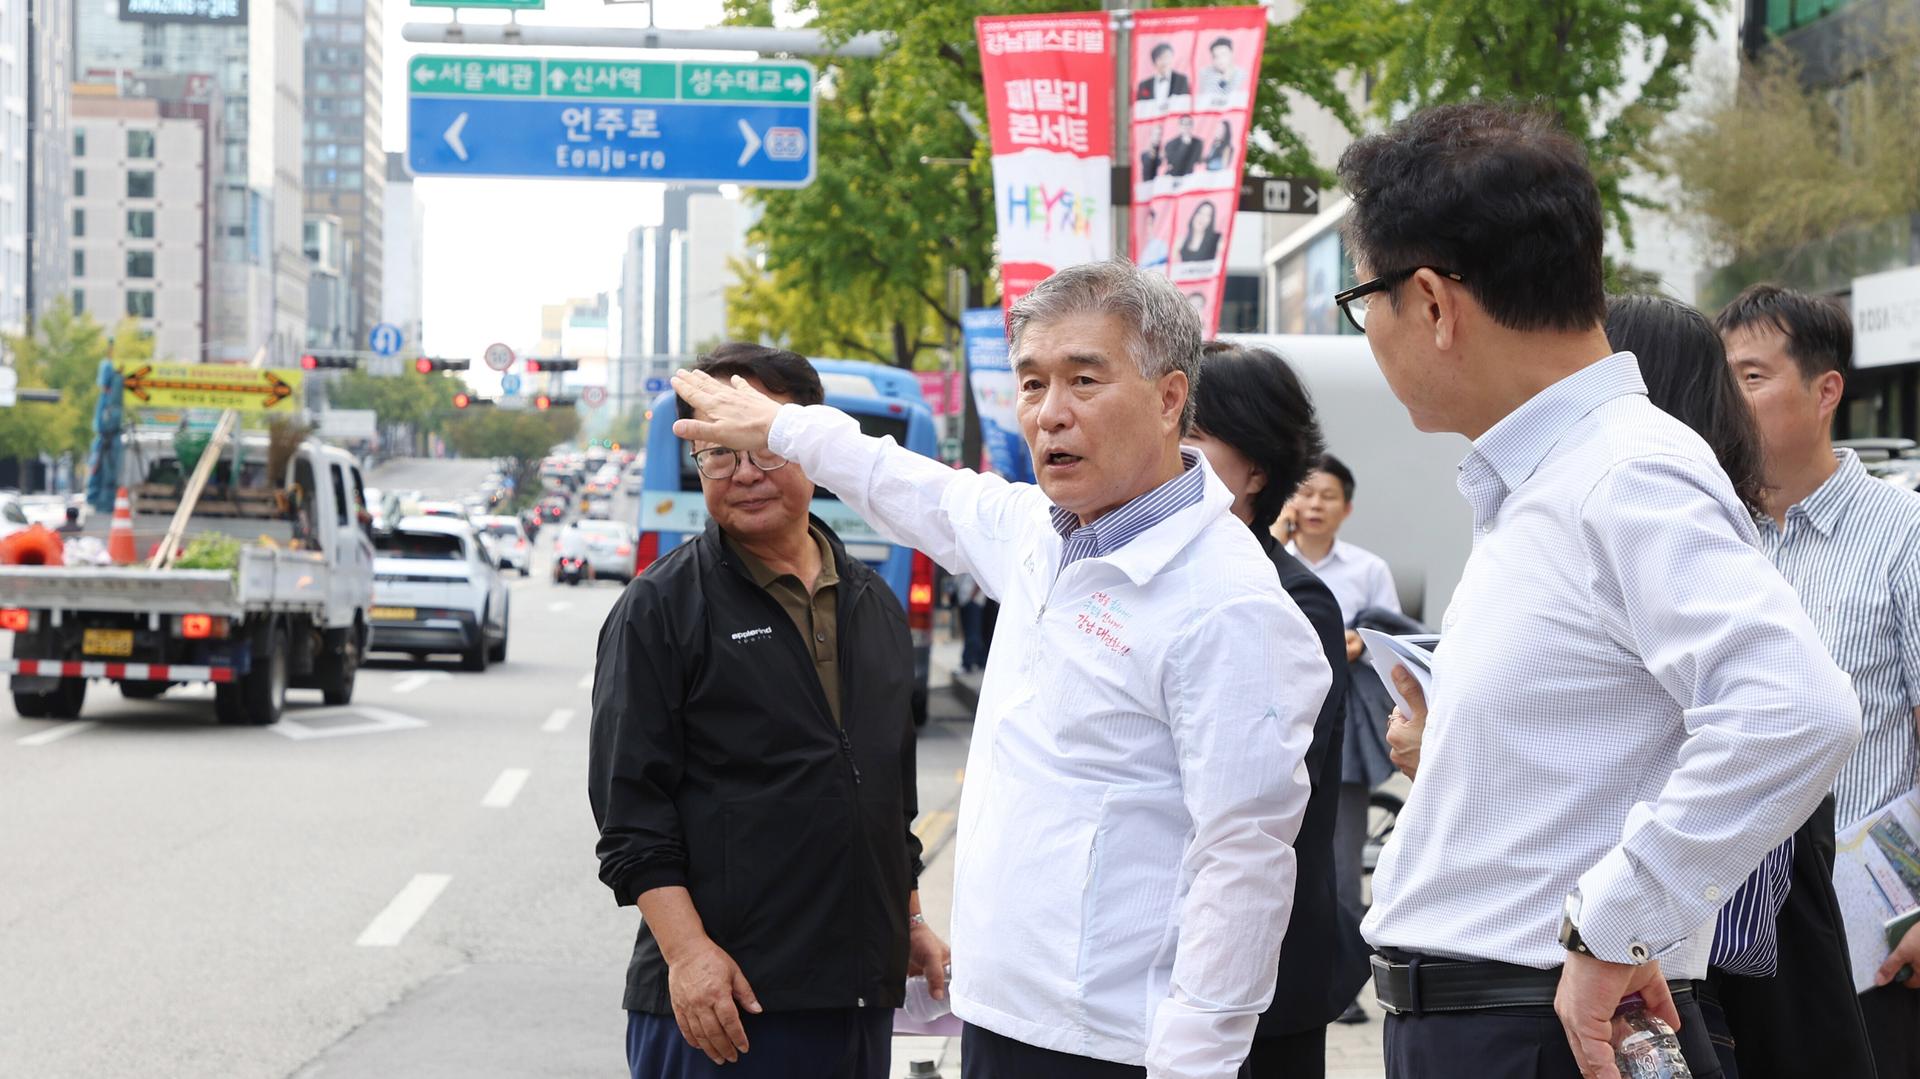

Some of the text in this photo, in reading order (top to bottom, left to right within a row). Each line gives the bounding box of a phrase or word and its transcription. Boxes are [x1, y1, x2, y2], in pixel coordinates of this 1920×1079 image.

[984, 29, 1104, 55] 강남페스티벌
[439, 62, 534, 91] 서울세관
[572, 66, 642, 93] 신사역
[688, 68, 782, 96] 성수대교
[1004, 78, 1088, 115] 패밀리
[561, 107, 662, 142] 언주로
[1008, 112, 1089, 152] 콘서트
[556, 144, 666, 172] Eonju-ro
[1008, 183, 1067, 234] HEY
[1078, 614, 1096, 635] 강남
